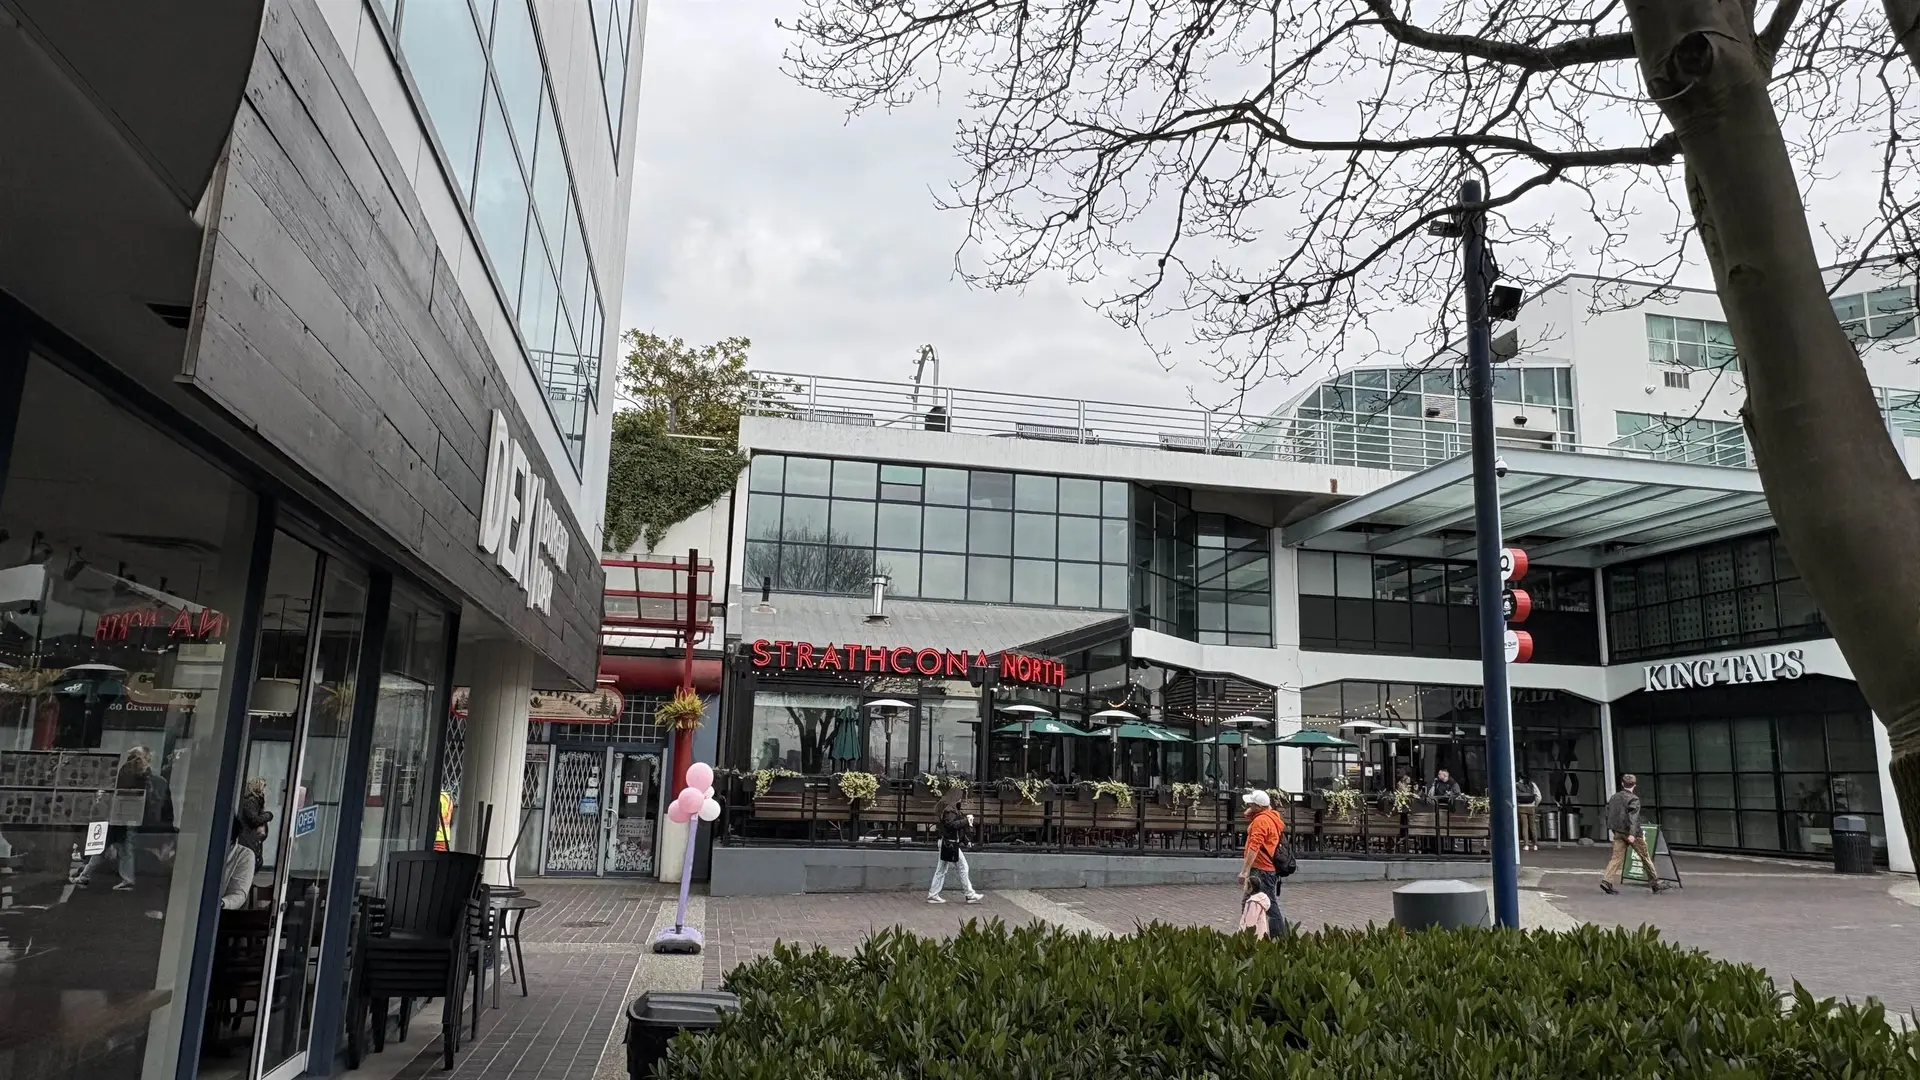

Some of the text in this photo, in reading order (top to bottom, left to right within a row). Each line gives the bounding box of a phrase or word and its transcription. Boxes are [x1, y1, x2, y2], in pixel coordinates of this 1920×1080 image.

[535, 558, 553, 617] BAR
[752, 638, 1065, 687] STRATHCONA NORTH
[1643, 649, 1806, 692] KING TAPS
[298, 809, 317, 828] OPEN
